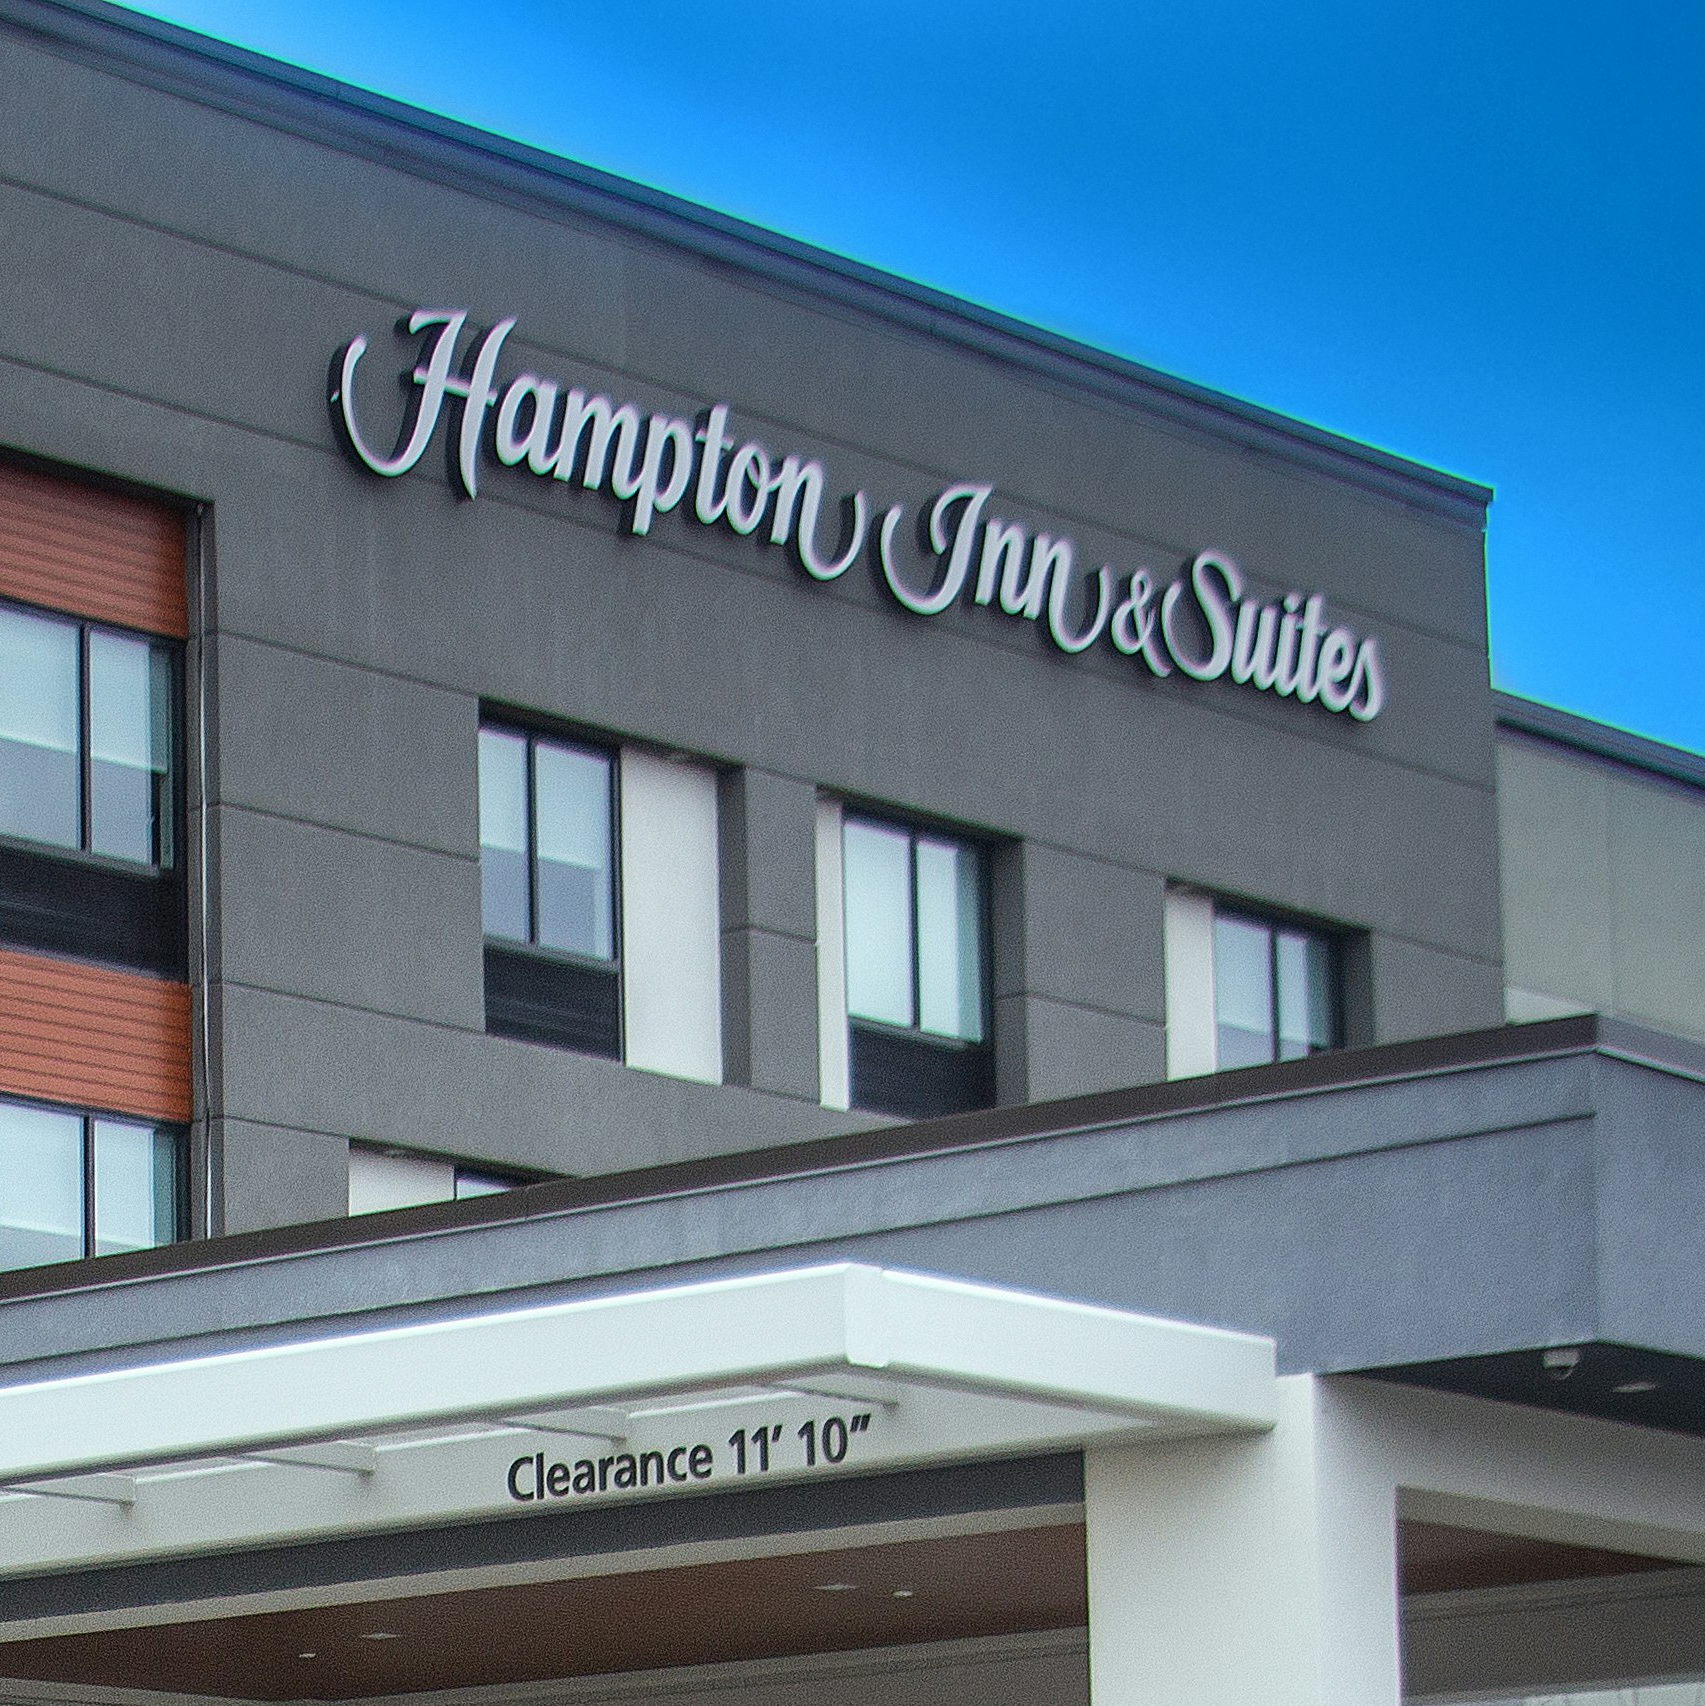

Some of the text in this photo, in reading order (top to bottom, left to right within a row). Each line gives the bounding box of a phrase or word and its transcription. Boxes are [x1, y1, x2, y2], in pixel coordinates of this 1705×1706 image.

[341, 308, 866, 581] Hampton
[881, 484, 1110, 653] Inn
[1162, 549, 1383, 722] Suites
[506, 1413, 872, 1501] Clearance 11' 10"
